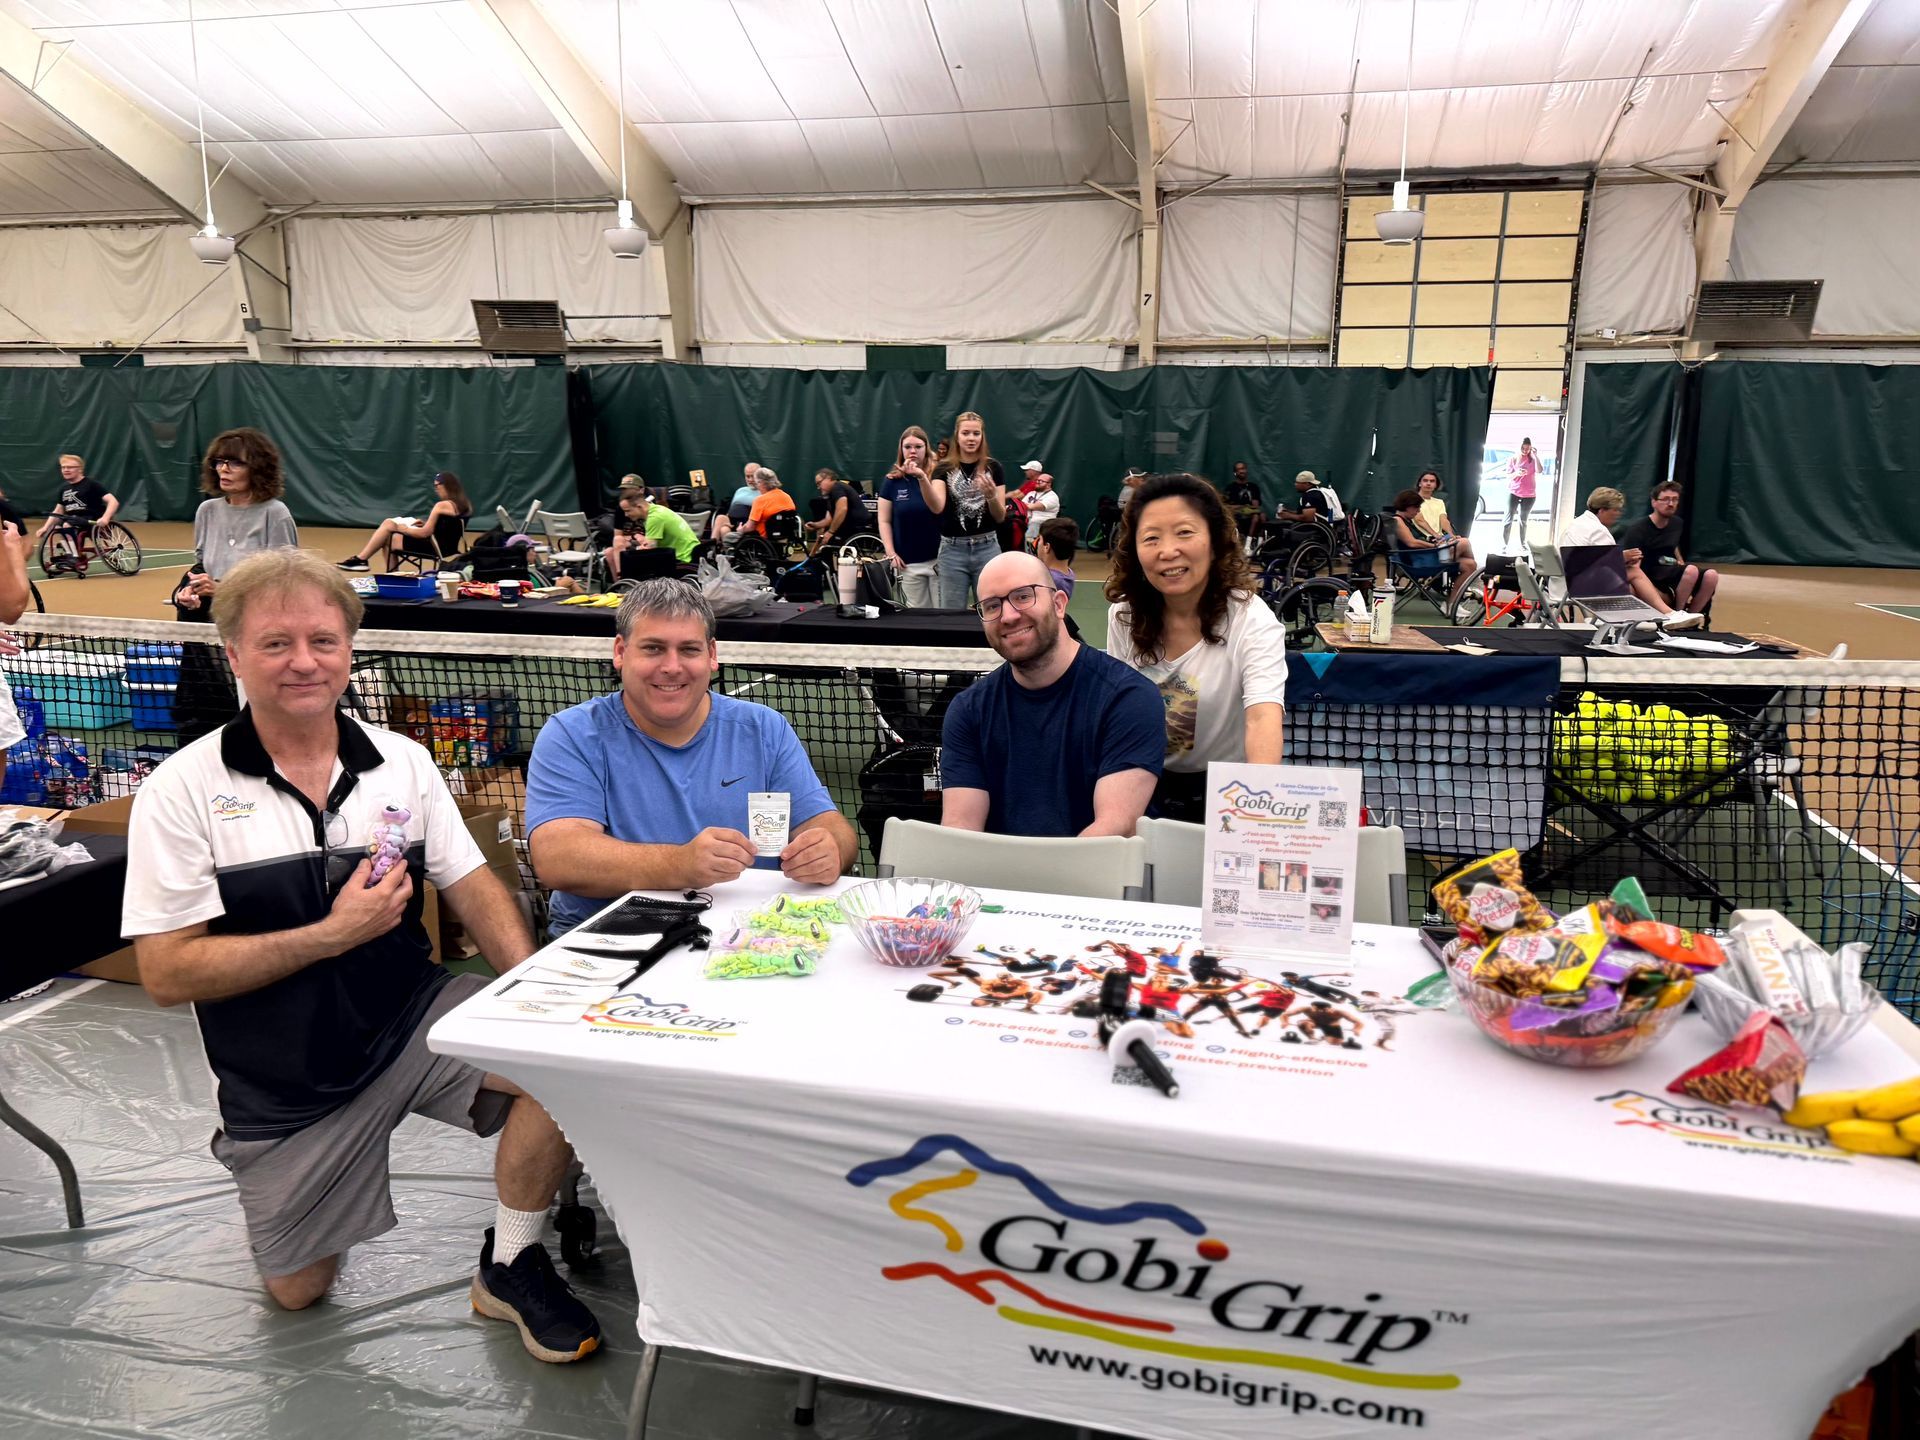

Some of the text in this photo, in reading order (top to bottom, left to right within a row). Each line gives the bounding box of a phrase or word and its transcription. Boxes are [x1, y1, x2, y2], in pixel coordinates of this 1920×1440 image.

[240, 303, 248, 313] 6
[1143, 294, 1152, 306] 7
[1473, 887, 1504, 907] Dot's
[1003, 909, 1100, 923] nnovative
[1104, 919, 1146, 927] grip
[1151, 923, 1202, 933] enha
[1475, 901, 1521, 925] Pretzels
[1079, 923, 1131, 934] total
[1131, 930, 1193, 940] game
[589, 1027, 719, 1042] www.gobigrip.com
[968, 1019, 1058, 1035] Fast-acting
[1175, 1054, 1335, 1077] Blister-prevention
[1230, 1048, 1369, 1068] Highly-effective
[1028, 1343, 1426, 1428] www.gobigrip.com
